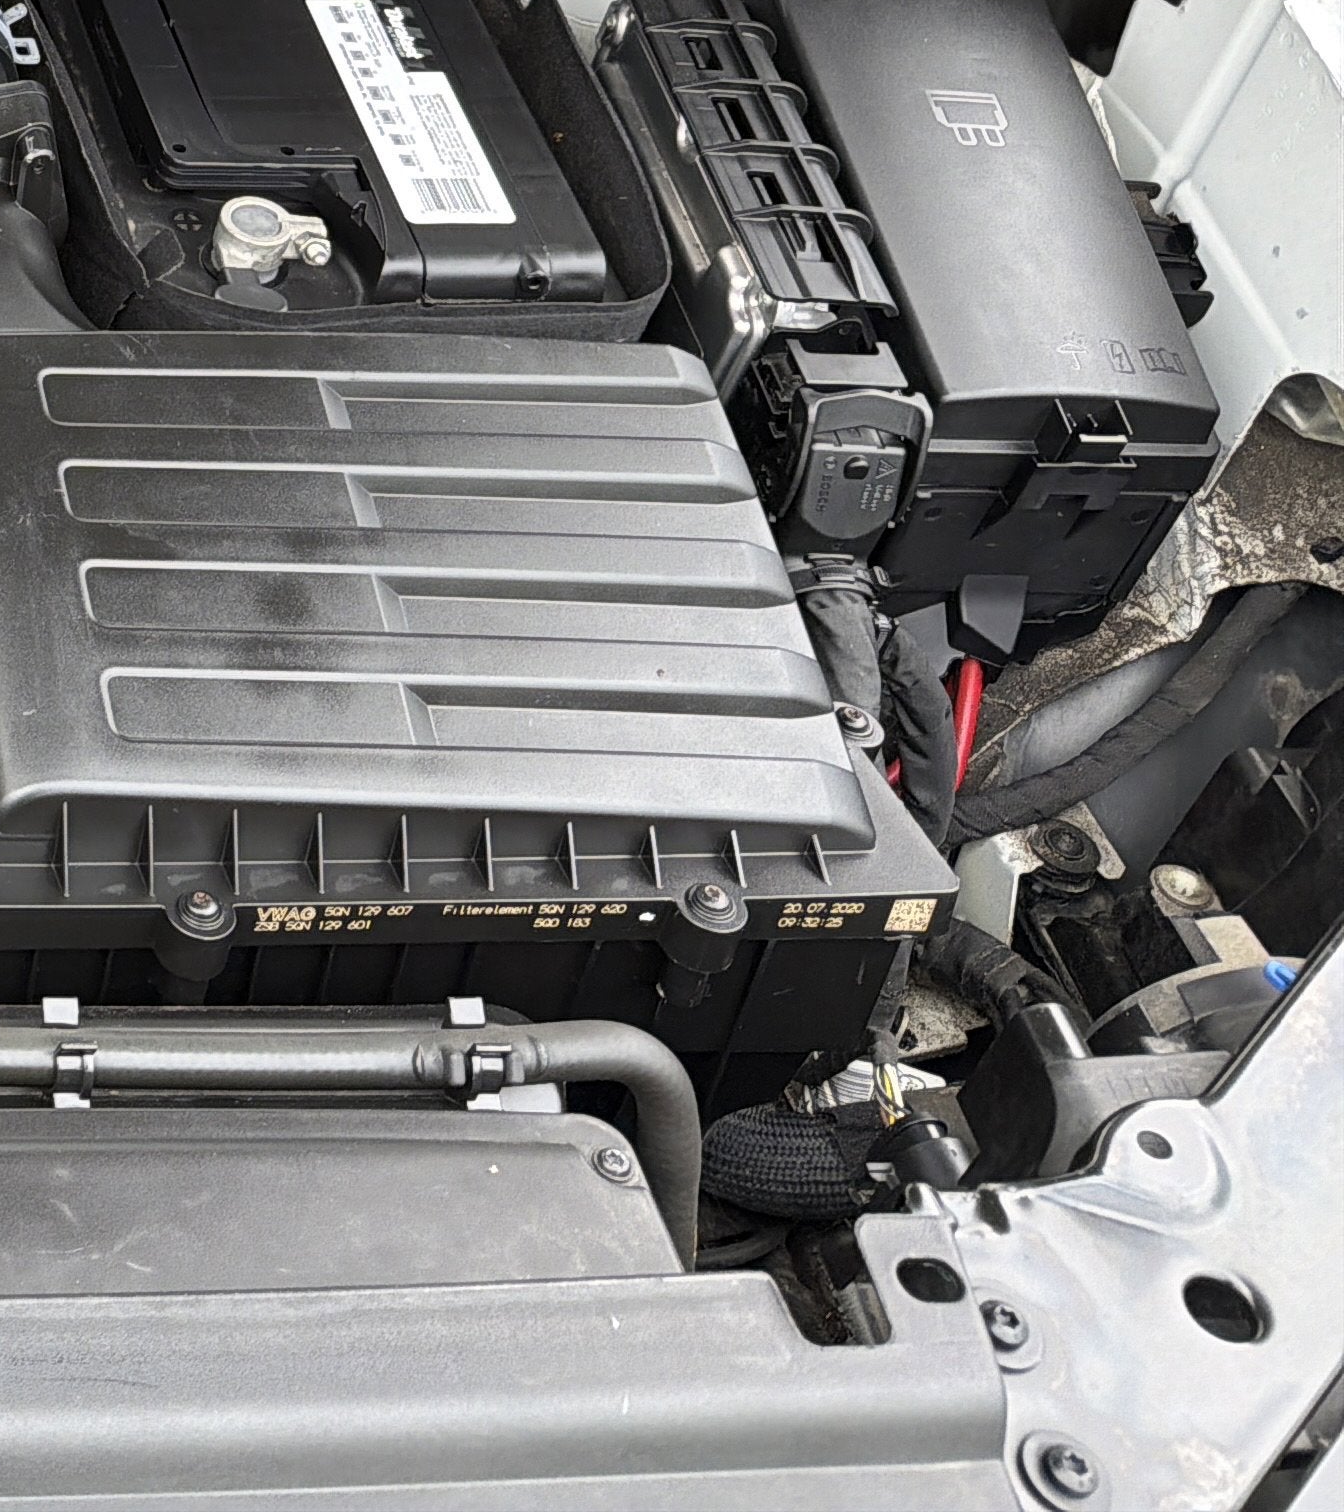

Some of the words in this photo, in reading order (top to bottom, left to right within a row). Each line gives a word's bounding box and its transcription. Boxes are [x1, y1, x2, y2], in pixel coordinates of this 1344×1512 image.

[382, 6, 423, 59] Duralast
[815, 474, 833, 513] BOSCH
[323, 905, 351, 918] 5QN
[357, 905, 382, 917] 129
[387, 905, 414, 917] 607
[442, 904, 534, 916] Filterelement
[538, 903, 566, 916] 5QN
[572, 903, 597, 915] 129
[600, 902, 628, 914] 620
[254, 920, 280, 932] ZSB
[284, 919, 312, 932] 5QN
[318, 919, 343, 931] 129
[347, 919, 372, 931] 601
[566, 916, 592, 928] 183
[777, 916, 844, 928] 09:32:25
